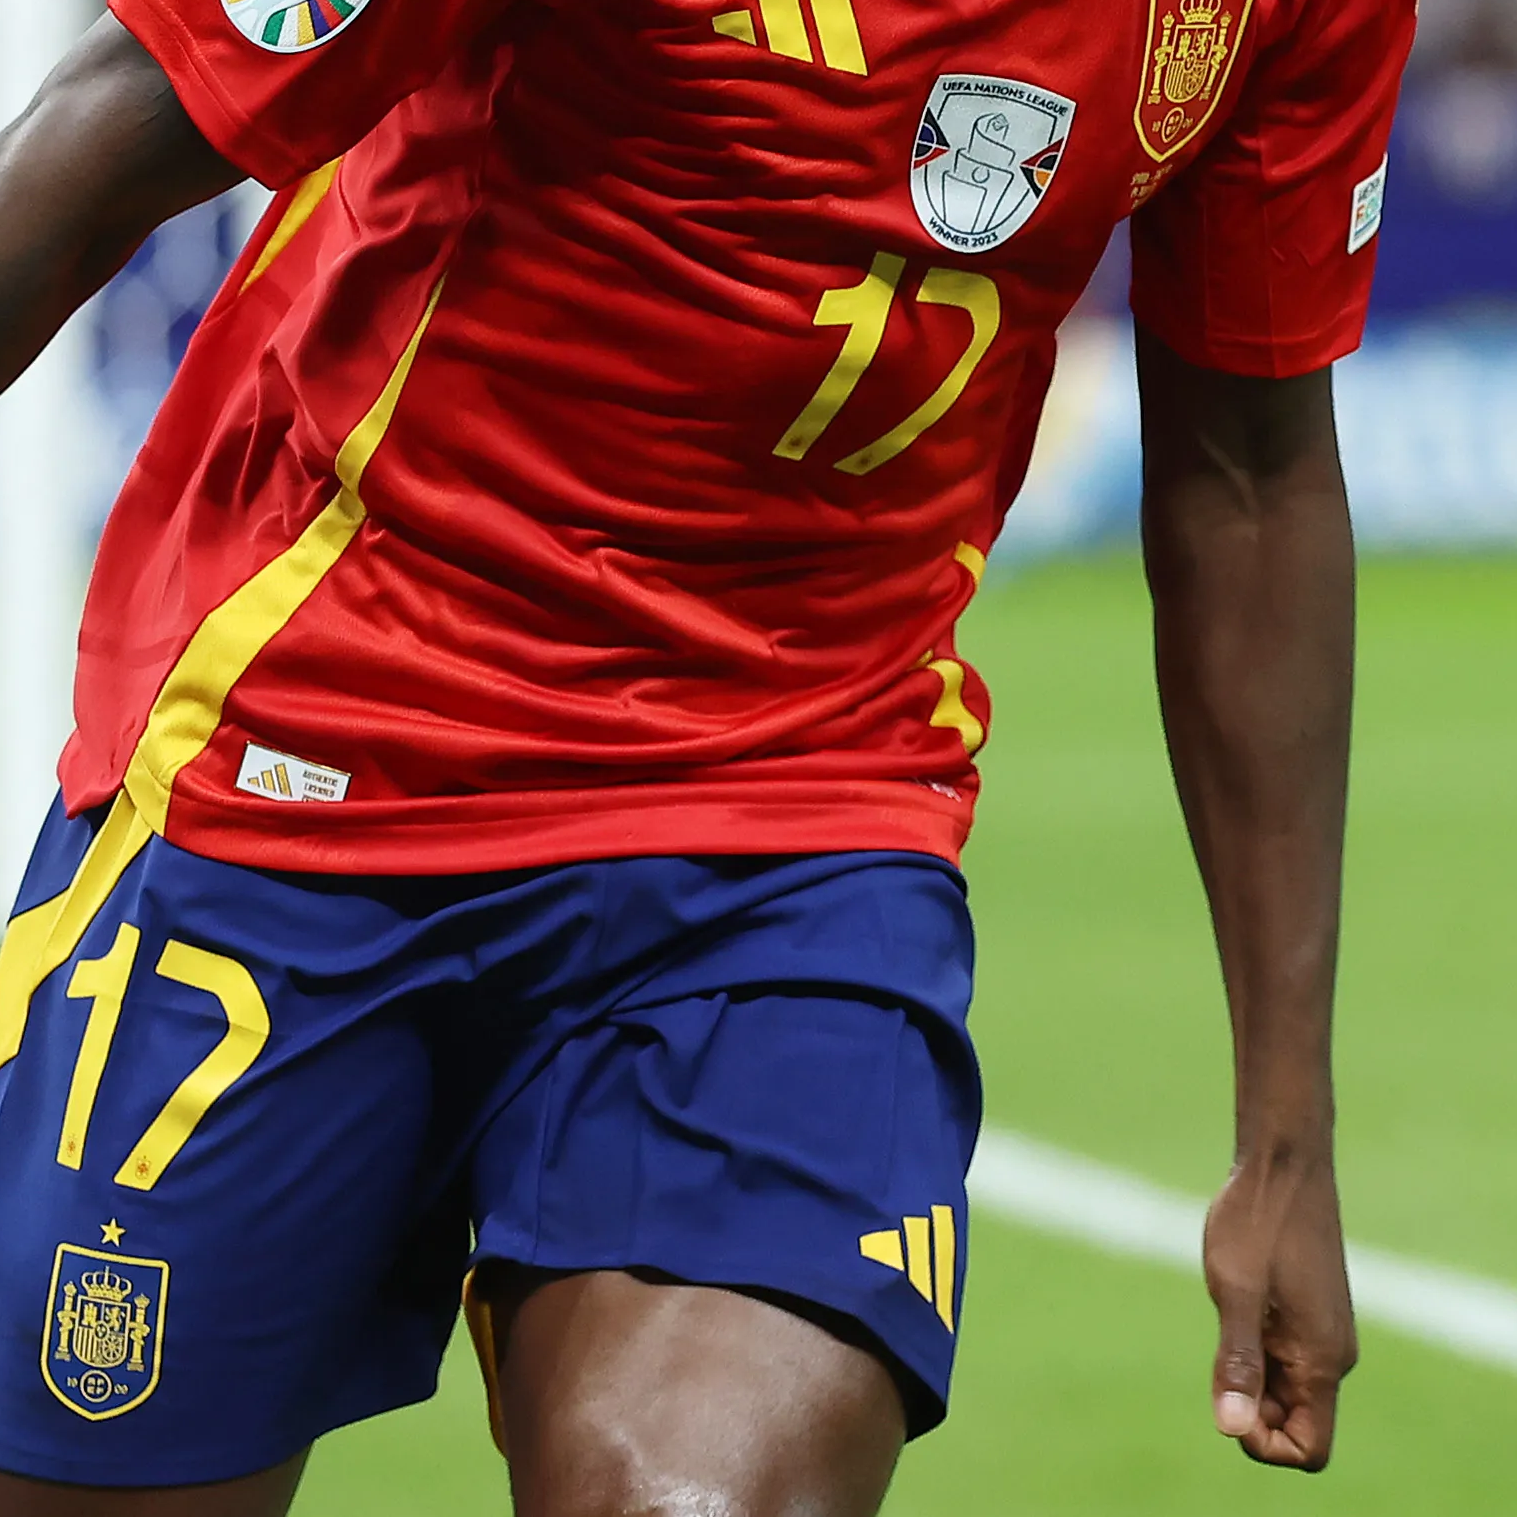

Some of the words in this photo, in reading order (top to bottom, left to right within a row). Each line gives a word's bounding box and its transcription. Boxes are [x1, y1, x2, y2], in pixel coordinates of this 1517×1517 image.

[942, 81, 972, 92] UEFA
[973, 82, 1025, 100] NATIONS
[1026, 92, 1069, 117] LEAGUE
[929, 216, 969, 247] WINNER
[970, 231, 999, 248] 2023
[772, 251, 1001, 476] 17
[56, 921, 271, 1192] 17
